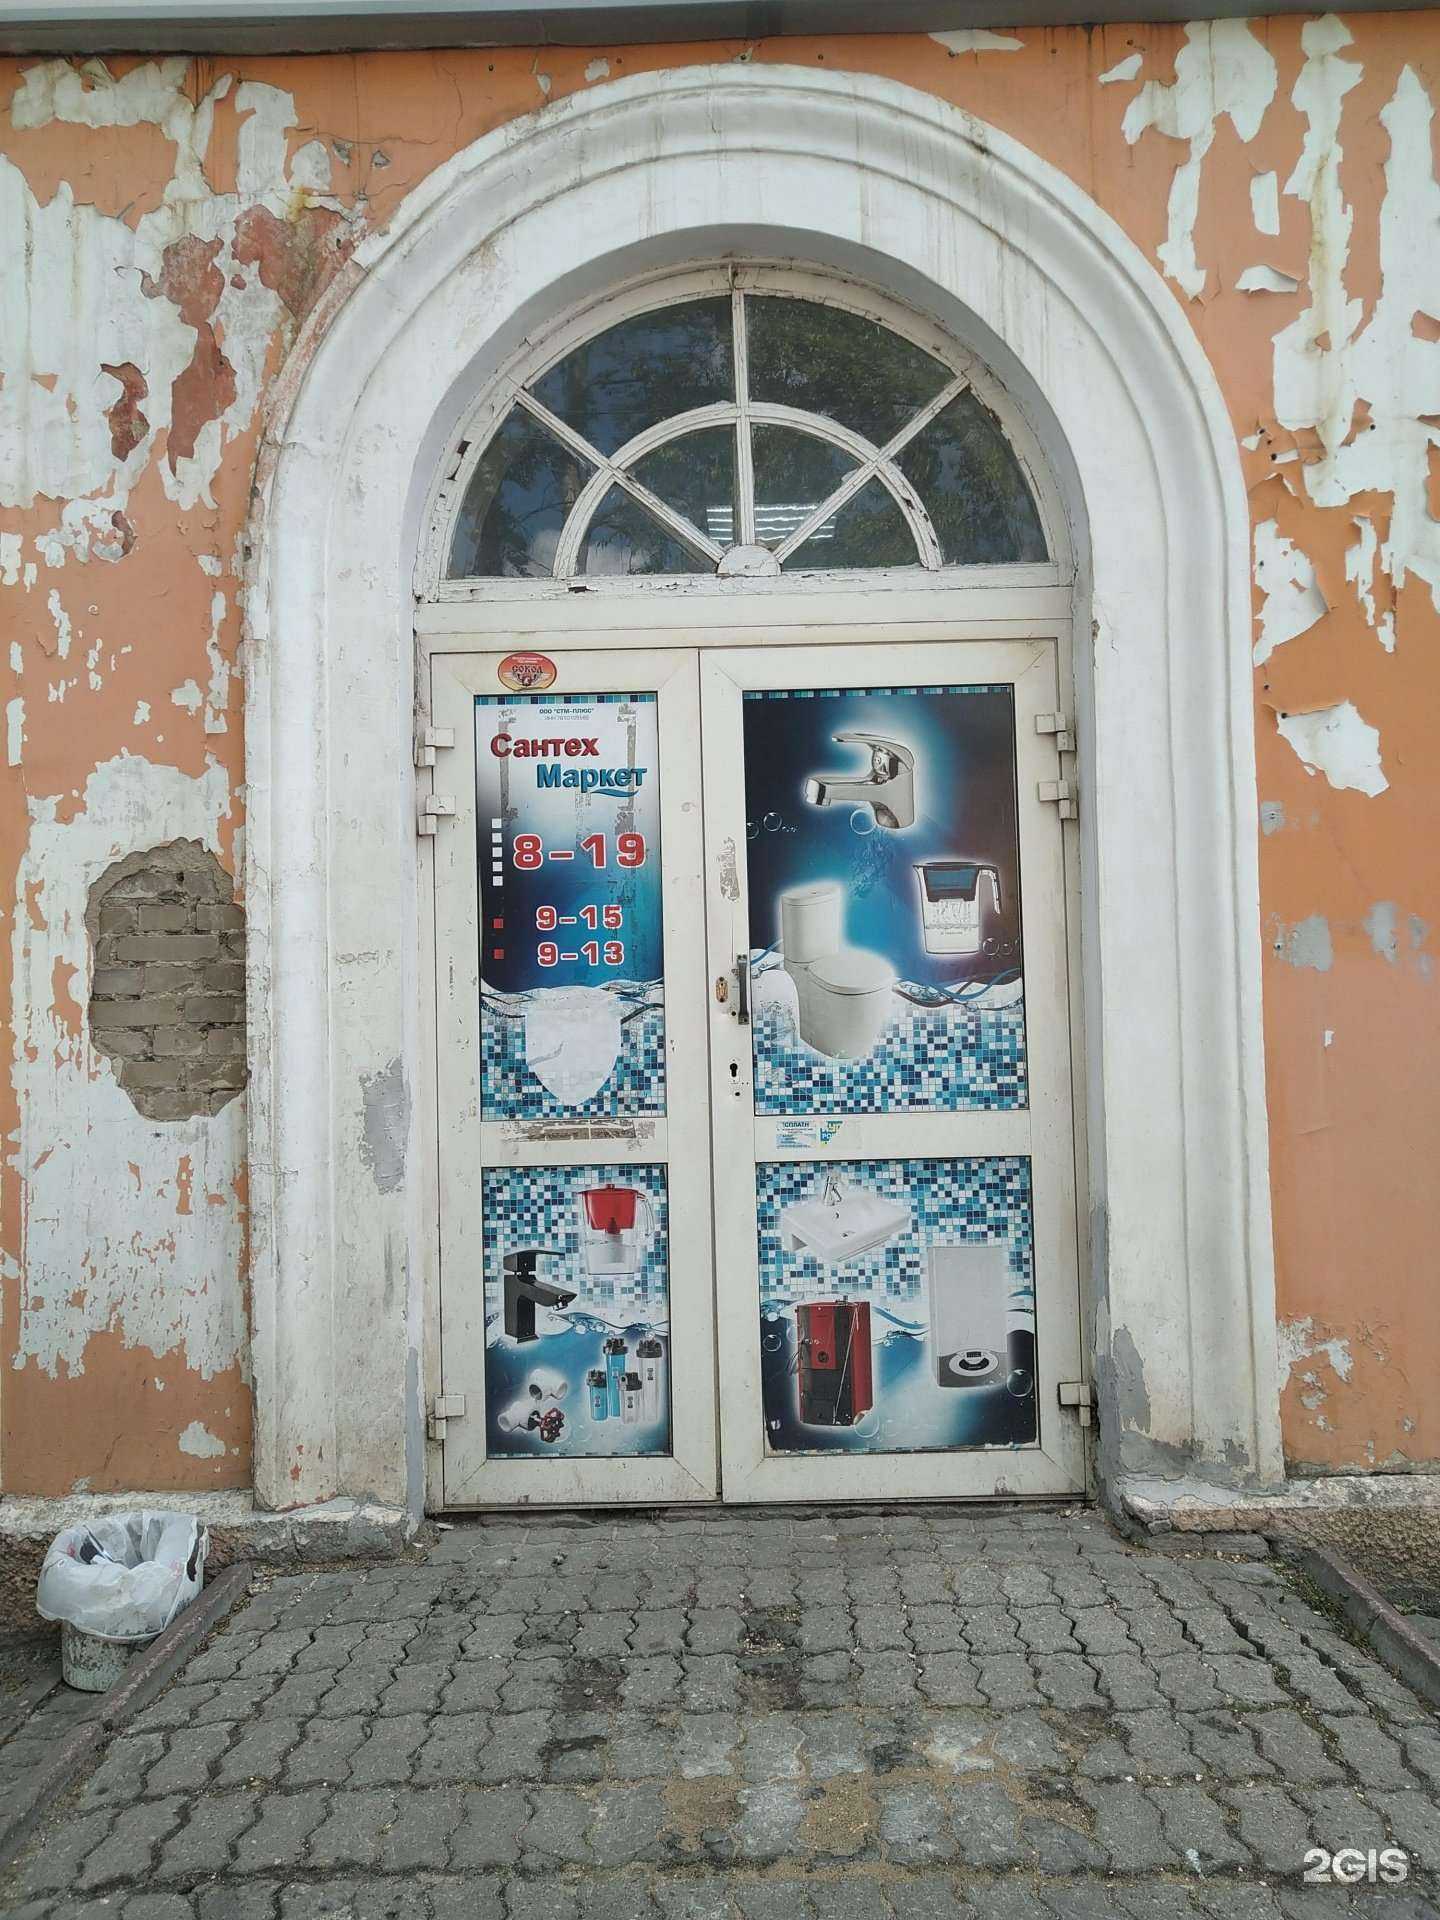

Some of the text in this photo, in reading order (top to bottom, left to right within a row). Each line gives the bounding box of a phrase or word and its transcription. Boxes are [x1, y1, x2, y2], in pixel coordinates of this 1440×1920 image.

[490, 732, 600, 758] Сантех
[536, 763, 648, 793] Маркет
[535, 904, 623, 930] 9-15
[537, 940, 624, 967] 9-13
